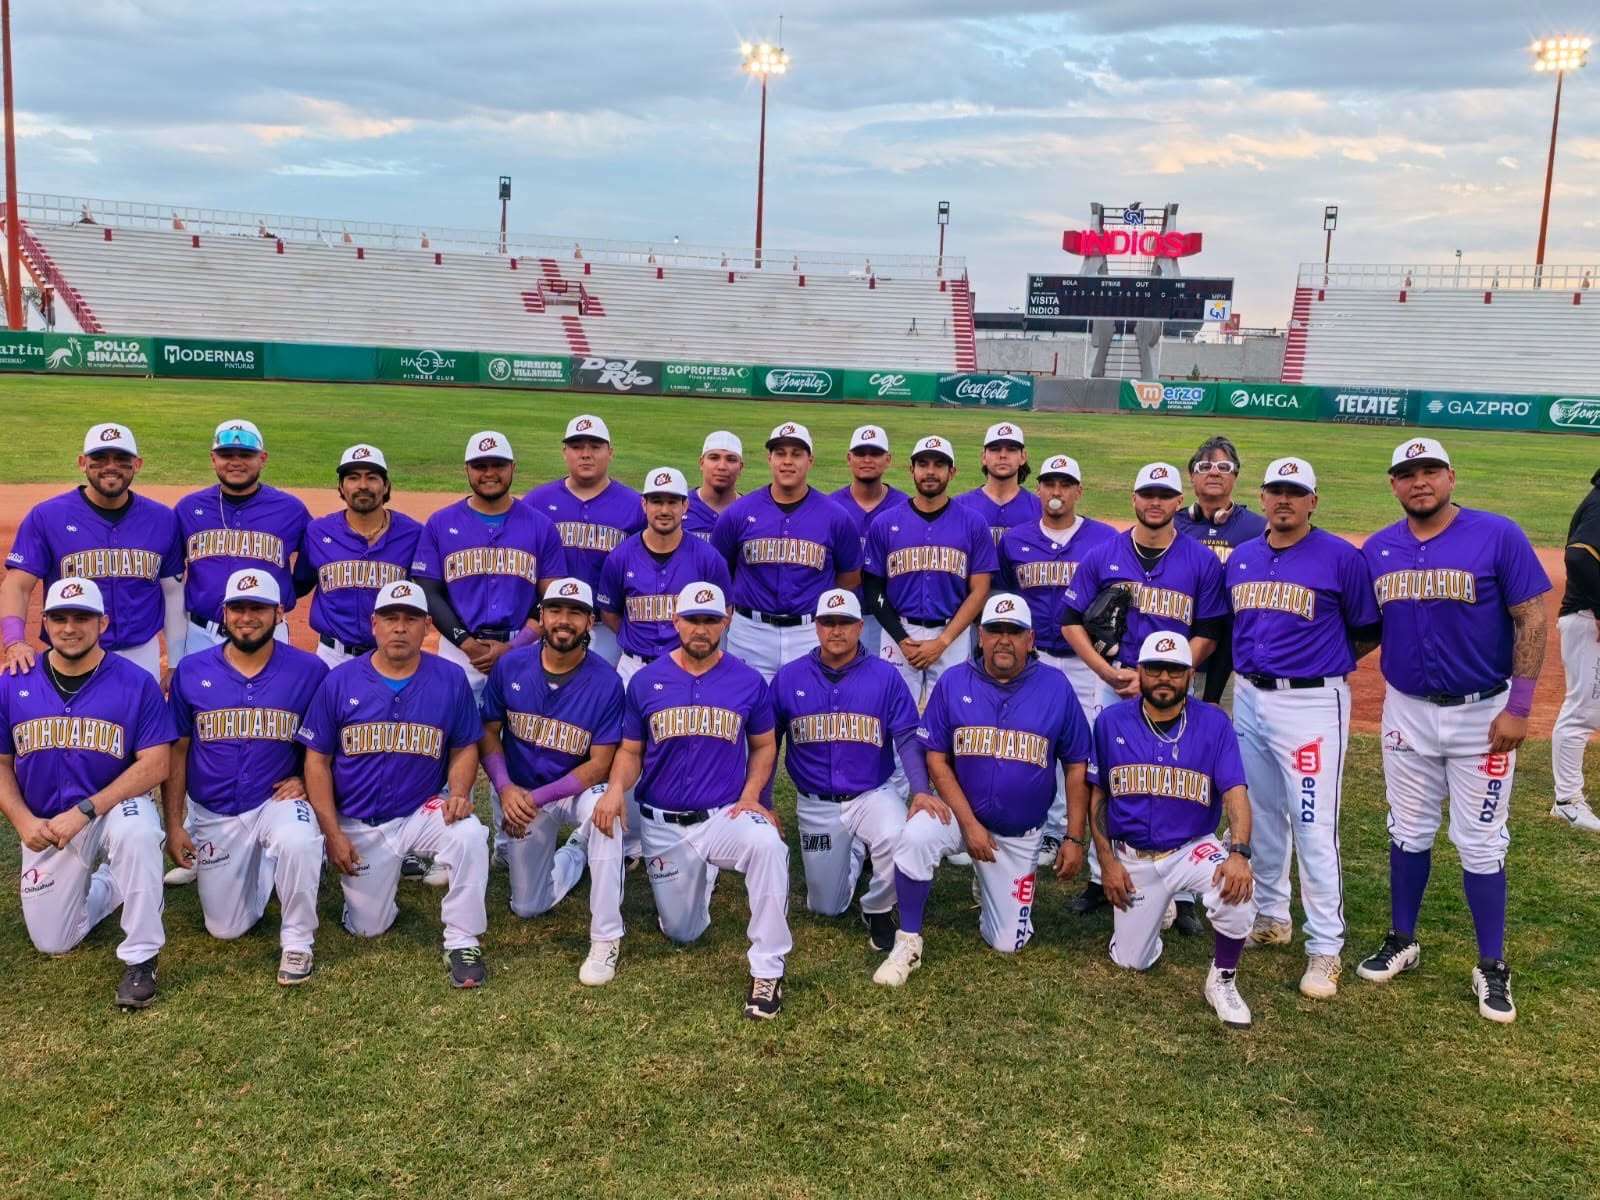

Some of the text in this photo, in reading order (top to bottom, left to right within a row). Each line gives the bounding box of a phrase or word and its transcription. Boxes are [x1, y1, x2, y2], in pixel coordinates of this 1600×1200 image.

[1080, 229, 1185, 257] INDIOS
[1029, 306, 1060, 315] INDIOS
[1030, 296, 1060, 305] VISITA
[87, 351, 148, 363] SINALOA
[94, 341, 140, 352] POLLO
[164, 345, 255, 364] MODERNAS
[400, 357, 456, 368] HARD BEAT
[580, 357, 638, 371] Del
[667, 365, 736, 376] COPROFESA
[1249, 393, 1299, 409] MEGA
[1334, 394, 1401, 415] TECATE
[1448, 400, 1529, 416] GAZPRO
[187, 529, 284, 568] CHIHUAHUA
[743, 538, 826, 571] CHIHUAHUA
[319, 560, 407, 593] CHIHUAHU
[445, 547, 536, 584] CHIHUAHUA
[887, 546, 967, 580] CHIHUAHUA
[1017, 561, 1079, 589] CHIHUA
[626, 595, 678, 622] CHIHUA
[1232, 581, 1314, 621] HIHUAHUA
[12, 717, 124, 759] CHIHUAHUA
[342, 722, 443, 759] CHIHUAHUA
[790, 713, 883, 748] CHIHUAHUA
[953, 726, 1048, 768] CHIHUAHUA
[1109, 764, 1210, 806] CHIHUAHUA
